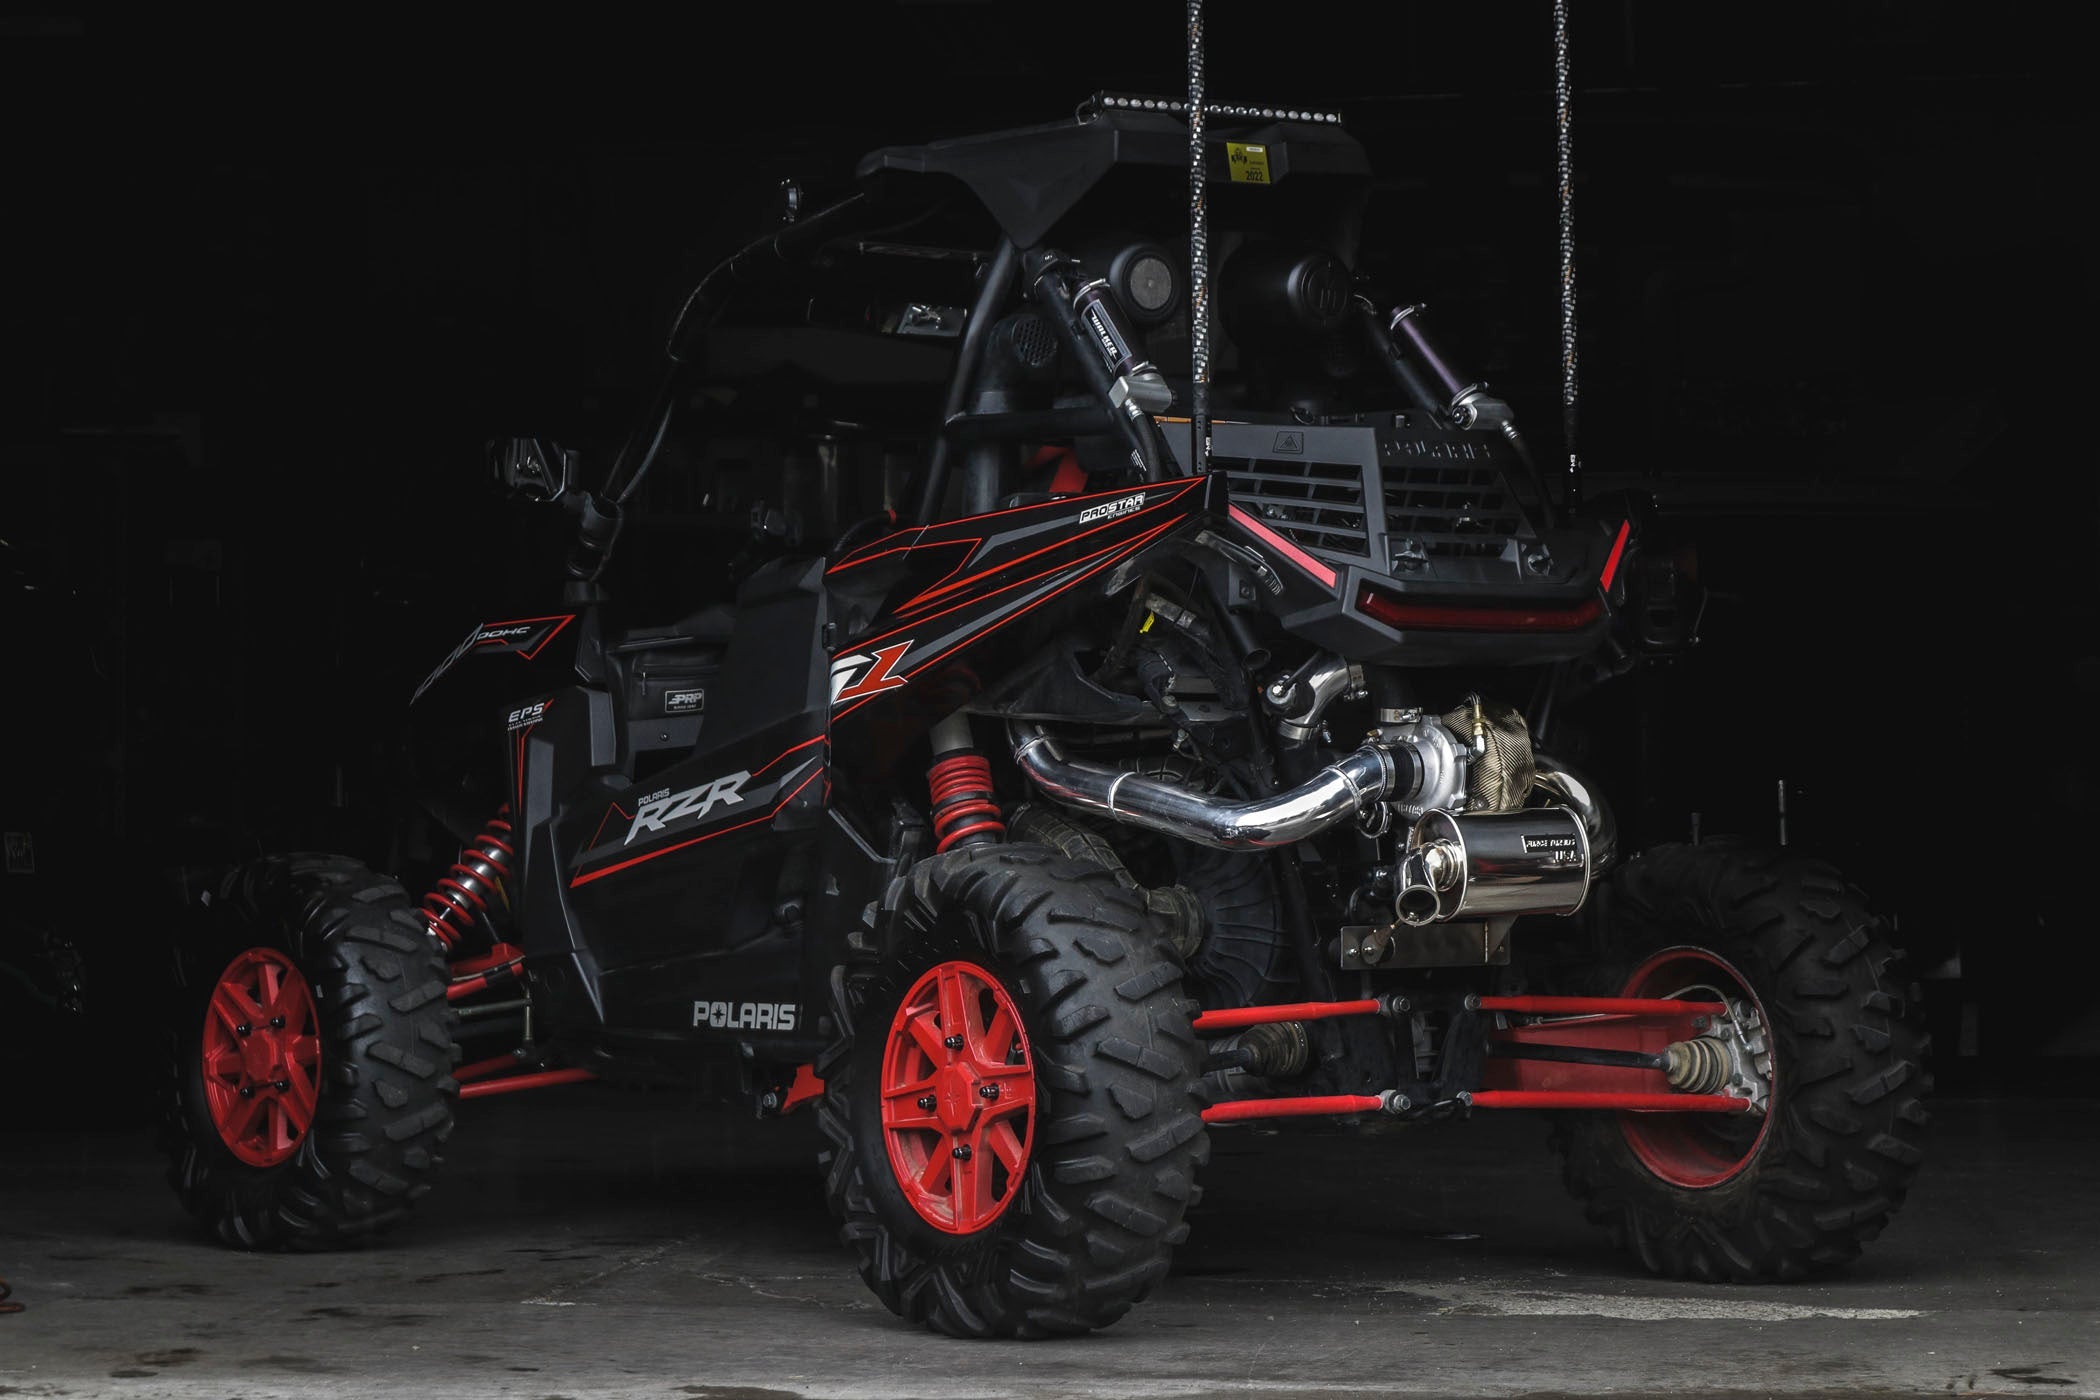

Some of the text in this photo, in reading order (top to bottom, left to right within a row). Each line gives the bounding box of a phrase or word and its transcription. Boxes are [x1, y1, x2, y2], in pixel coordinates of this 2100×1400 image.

[1246, 170, 1264, 182] 2022
[1080, 493, 1145, 523] PROSTAR
[477, 626, 531, 640] DOHC
[508, 702, 545, 723] EPS
[624, 769, 752, 846] RZR
[638, 788, 671, 806] POLARIS
[693, 1001, 796, 1031] POLARIS
